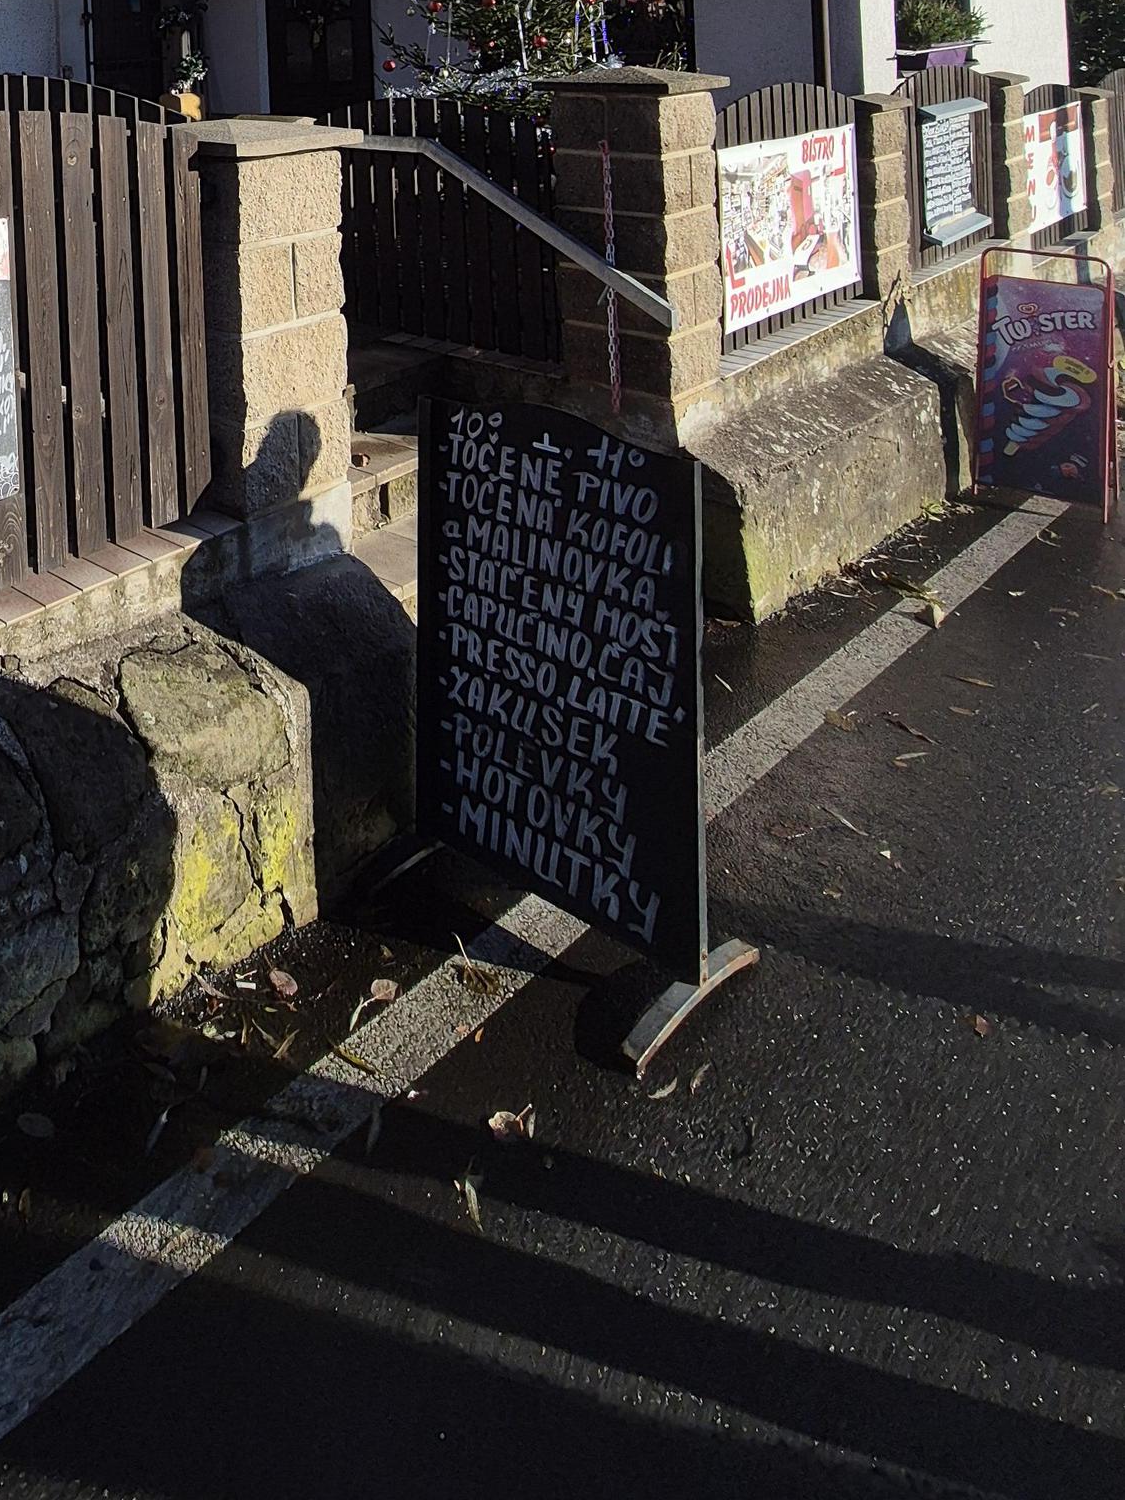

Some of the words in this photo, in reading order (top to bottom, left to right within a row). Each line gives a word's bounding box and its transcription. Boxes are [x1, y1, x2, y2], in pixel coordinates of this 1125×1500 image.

[801, 134, 835, 164] BISTRO
[730, 274, 791, 321] PRODEJNA
[571, 470, 659, 525] PIVO
[442, 520, 463, 539] a
[465, 514, 657, 613] MALINOVKA
[594, 598, 679, 668] MOŠT
